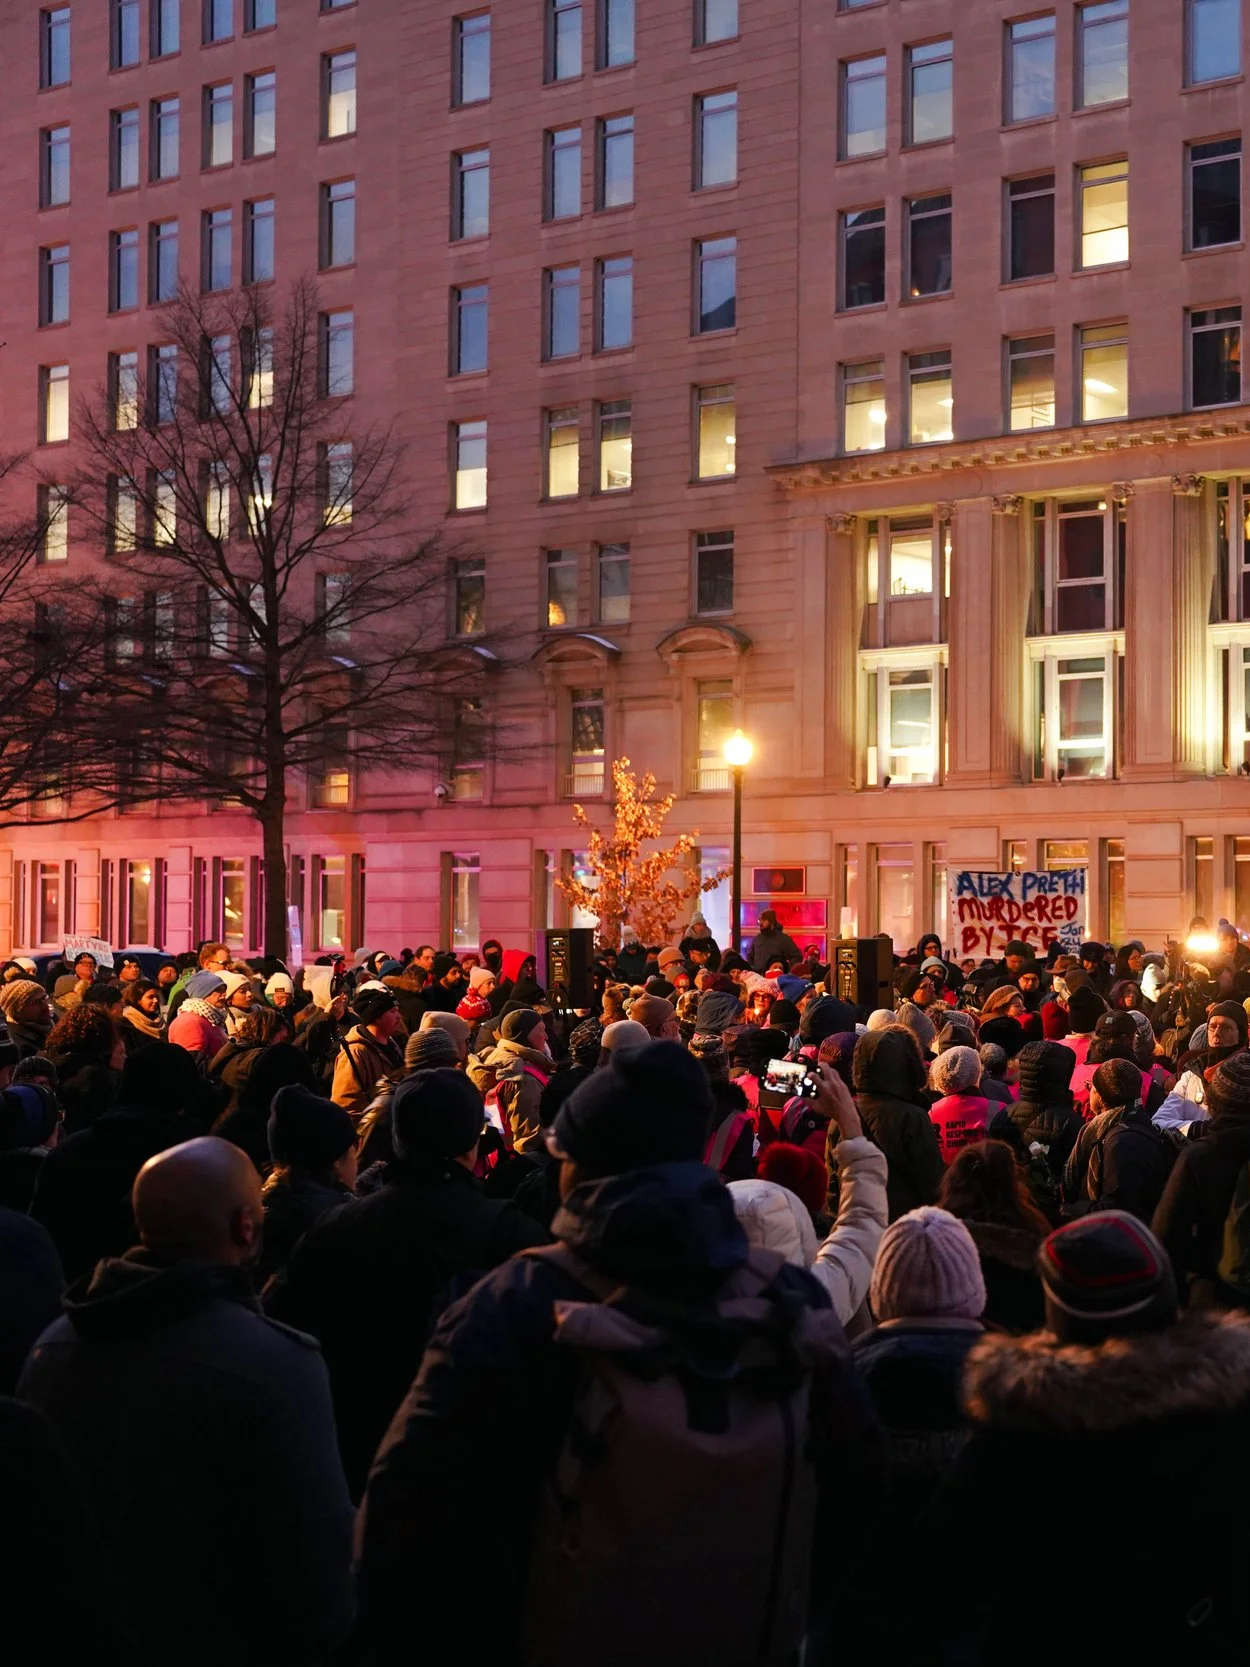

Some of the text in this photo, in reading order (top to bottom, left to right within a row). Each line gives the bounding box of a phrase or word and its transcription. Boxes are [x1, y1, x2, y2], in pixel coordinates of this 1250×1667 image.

[956, 871, 1015, 899] ALEX
[961, 925, 1058, 956] BY ICE
[1060, 921, 1085, 936] Jan
